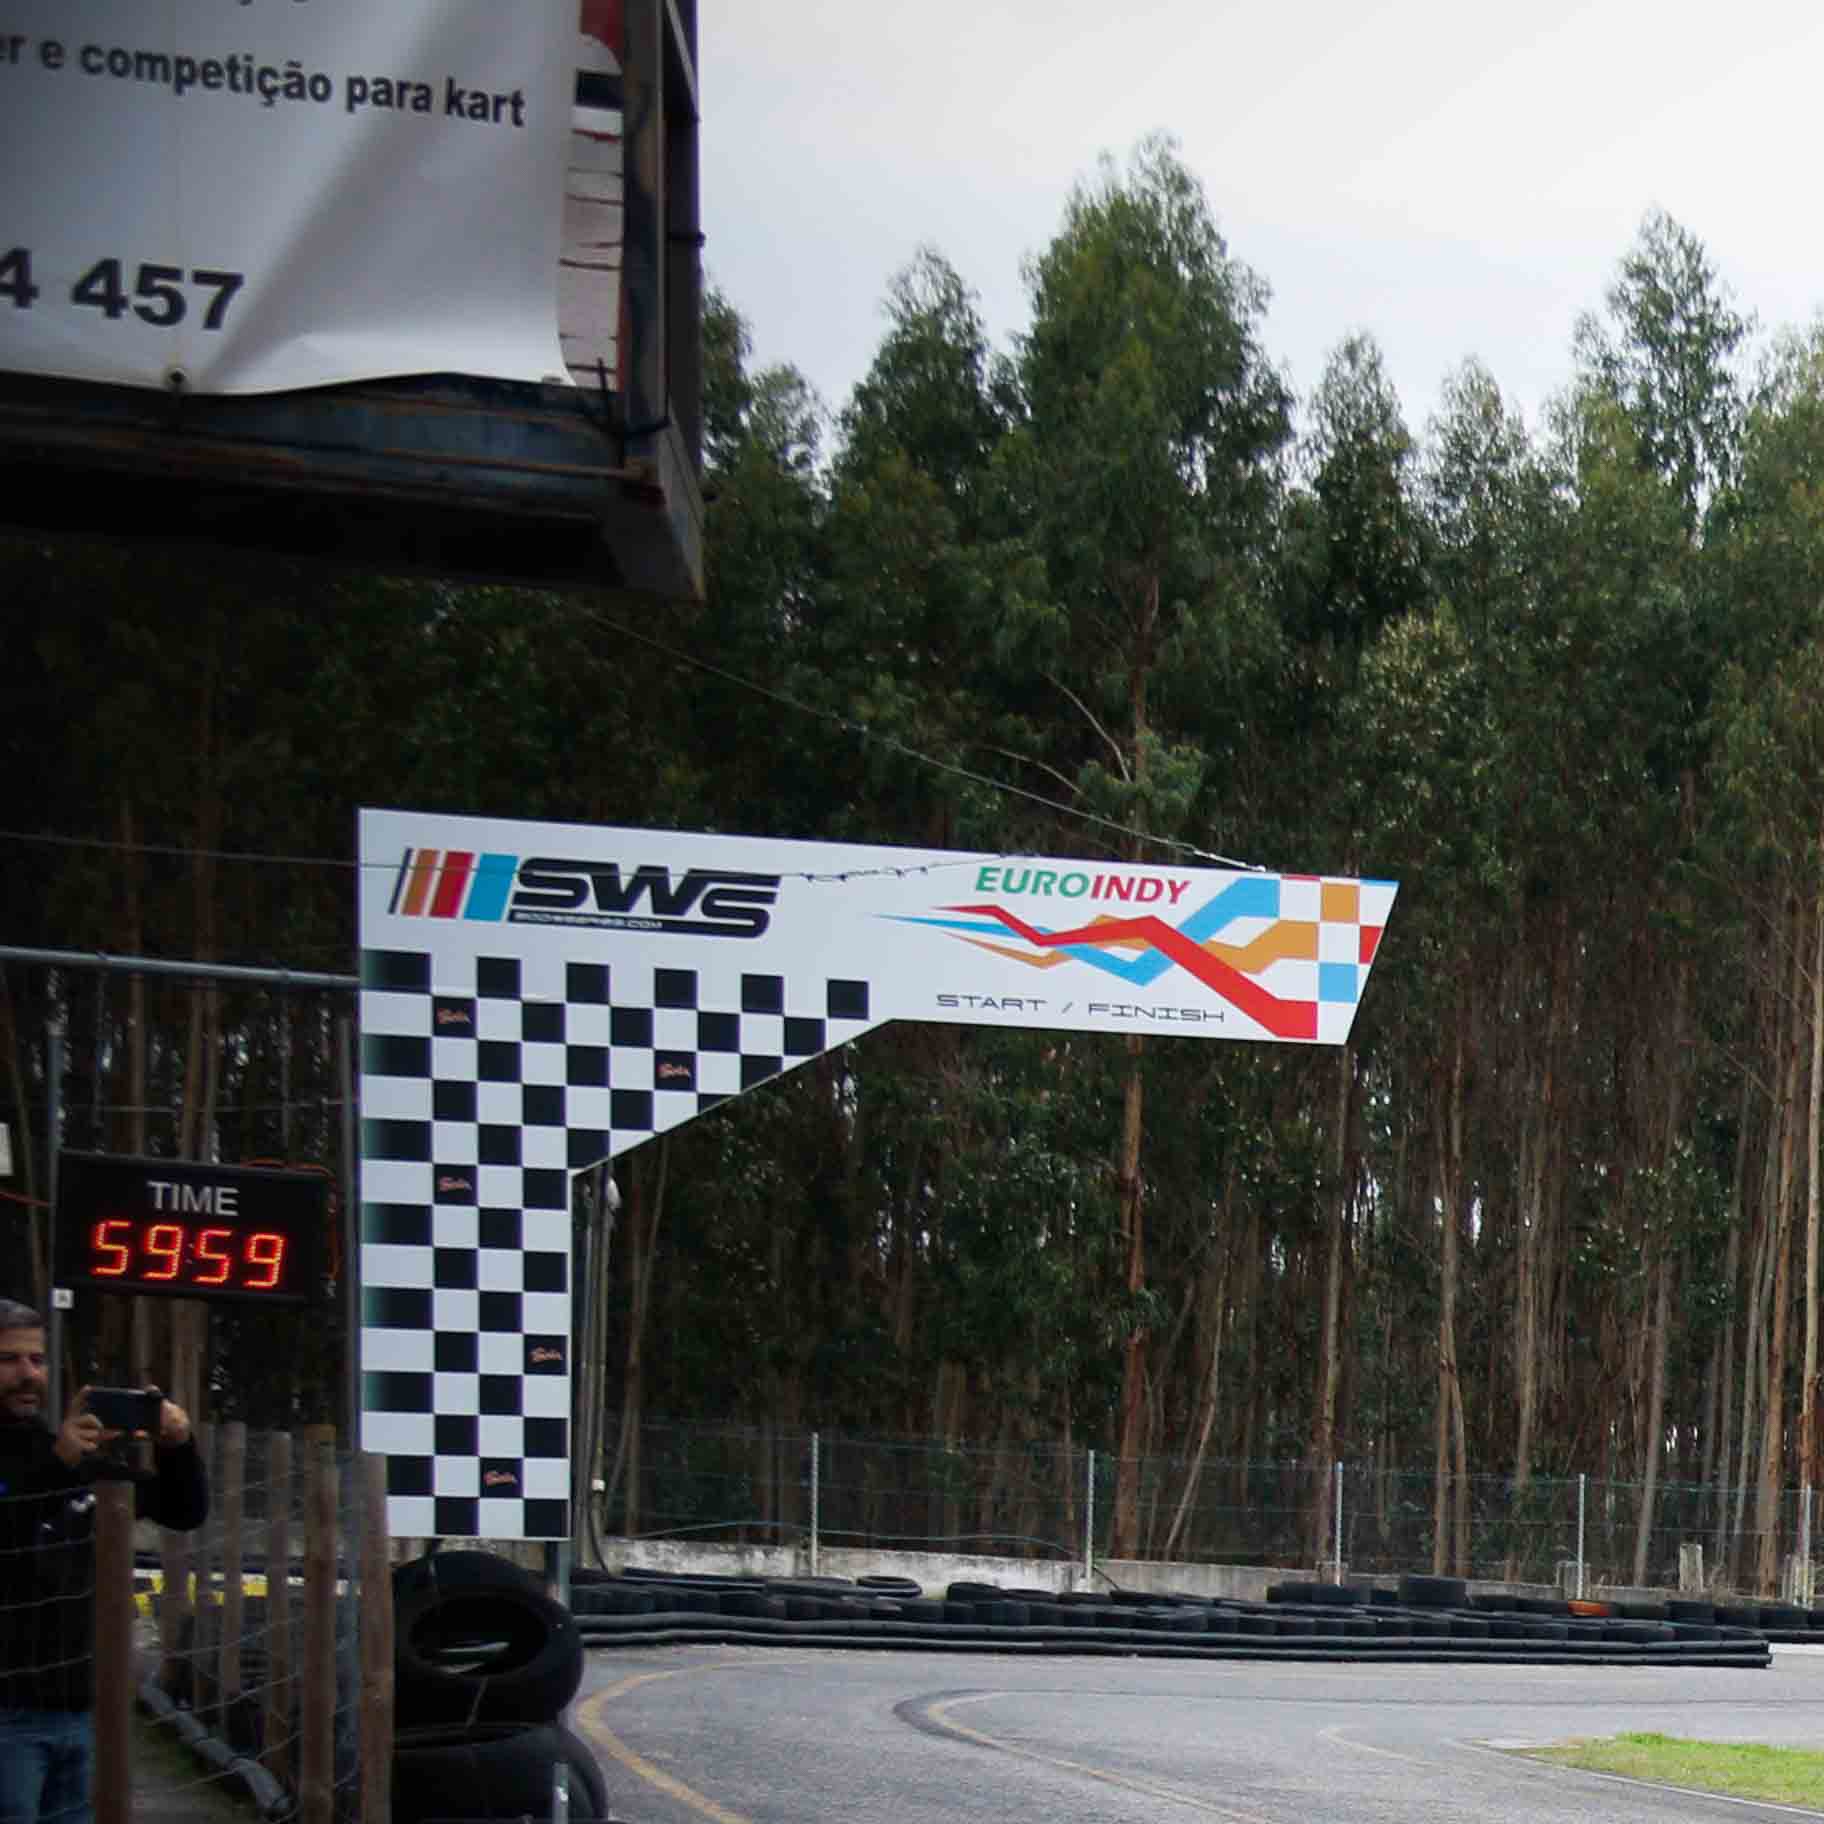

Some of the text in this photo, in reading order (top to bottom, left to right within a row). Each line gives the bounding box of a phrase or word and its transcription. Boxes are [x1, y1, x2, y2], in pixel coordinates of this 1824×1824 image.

[0, 34, 526, 128] r e competição para kart
[71, 257, 244, 331] 457
[508, 857, 782, 938] SWS
[974, 866, 1191, 905] EUROINDY
[936, 993, 1048, 1014] START
[1087, 1002, 1226, 1024] FINISH
[146, 1180, 240, 1217] TIME
